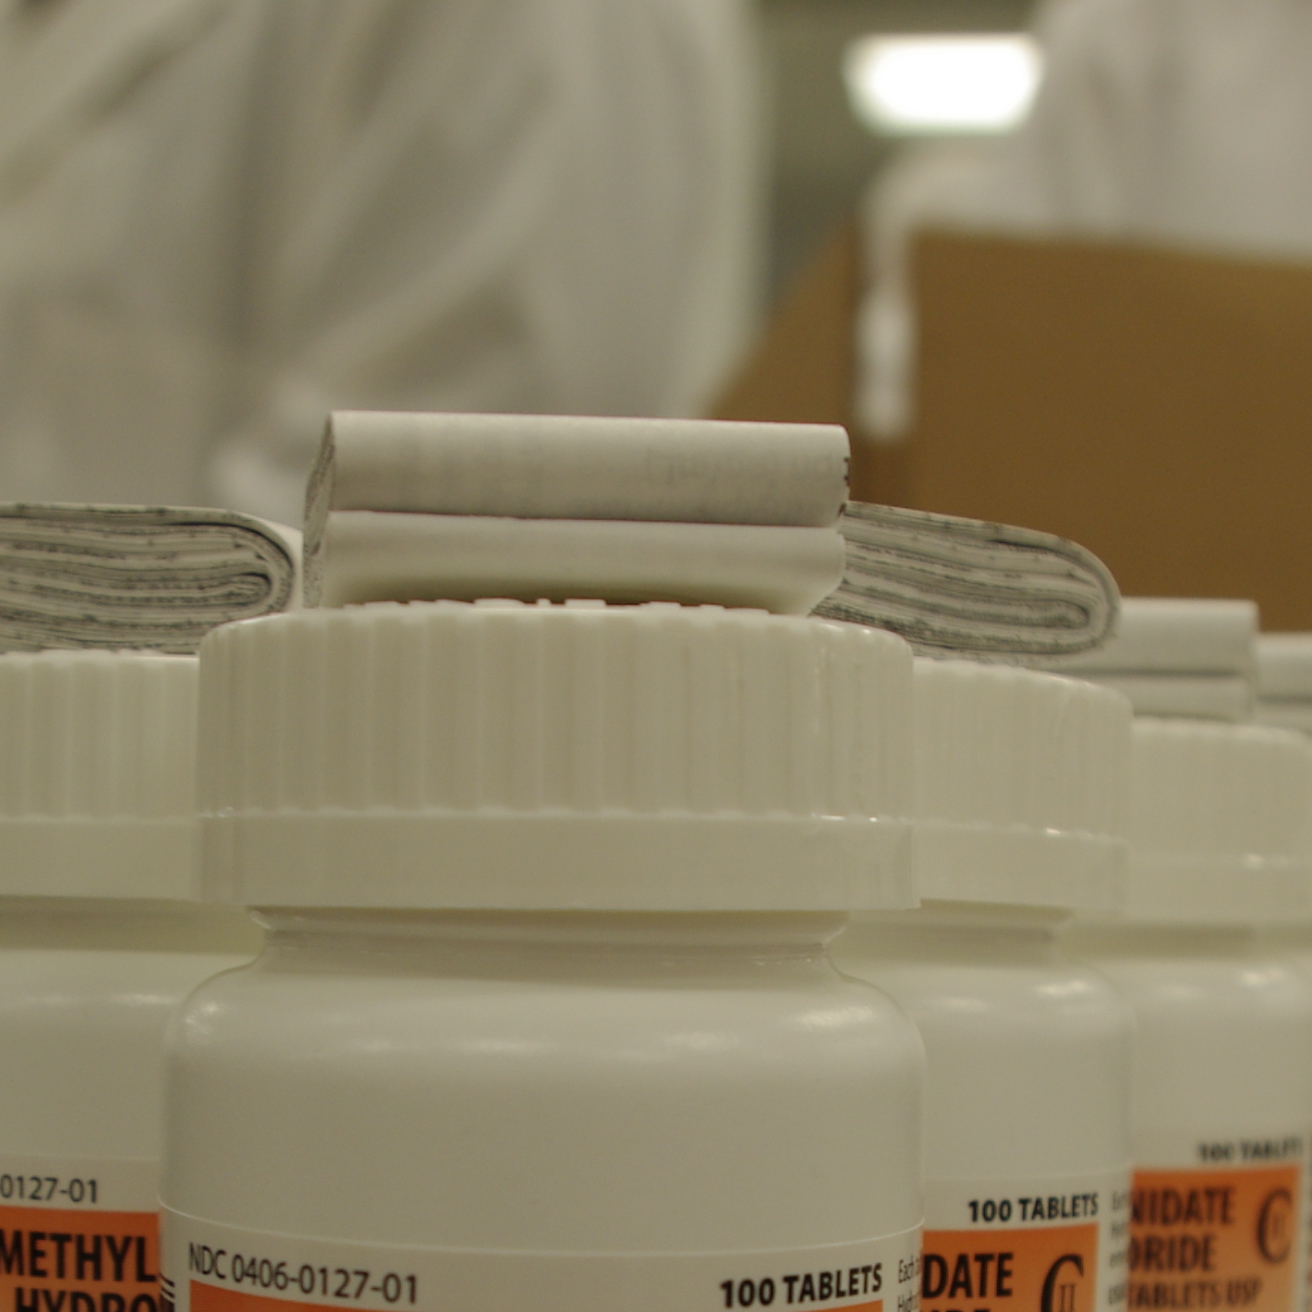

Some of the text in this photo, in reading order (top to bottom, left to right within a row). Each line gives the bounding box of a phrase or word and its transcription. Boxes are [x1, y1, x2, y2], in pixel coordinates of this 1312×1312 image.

[968, 1193, 1100, 1223] 100 TABLETS
[188, 1242, 419, 1305] NDC 0406-0127-01
[719, 1262, 884, 1309] 100 TABLETS
